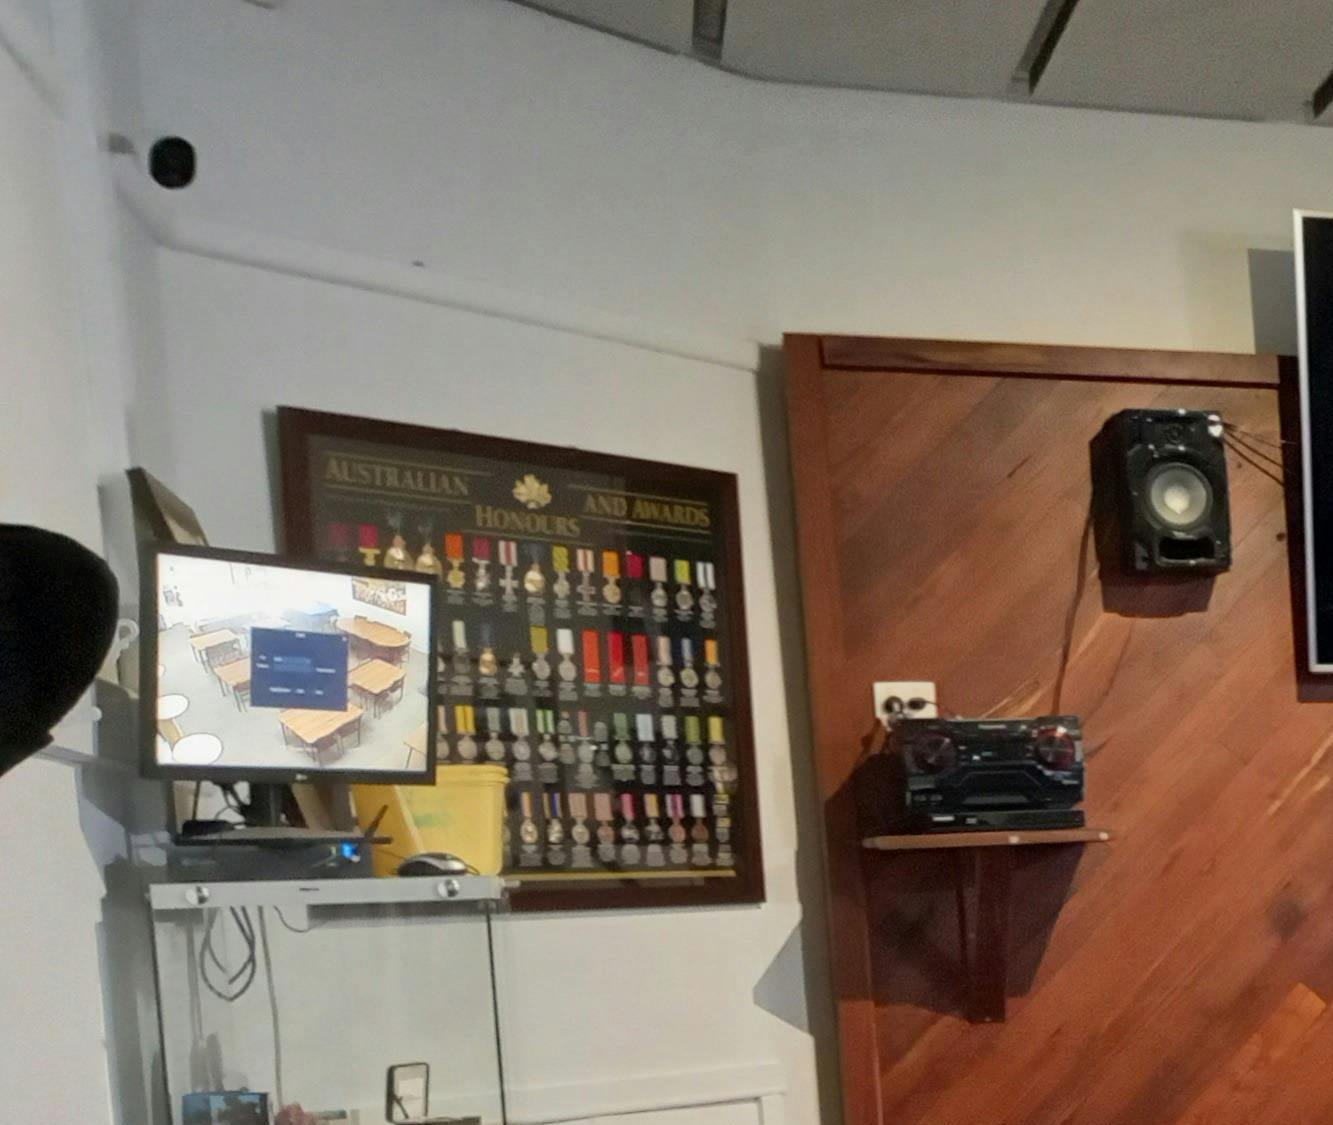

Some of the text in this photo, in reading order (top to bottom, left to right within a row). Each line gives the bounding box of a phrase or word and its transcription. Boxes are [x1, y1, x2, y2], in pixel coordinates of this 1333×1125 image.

[325, 457, 469, 496] AUSTRALIAN
[475, 504, 581, 537] HONOURS
[584, 492, 711, 527] AND AWARDS
